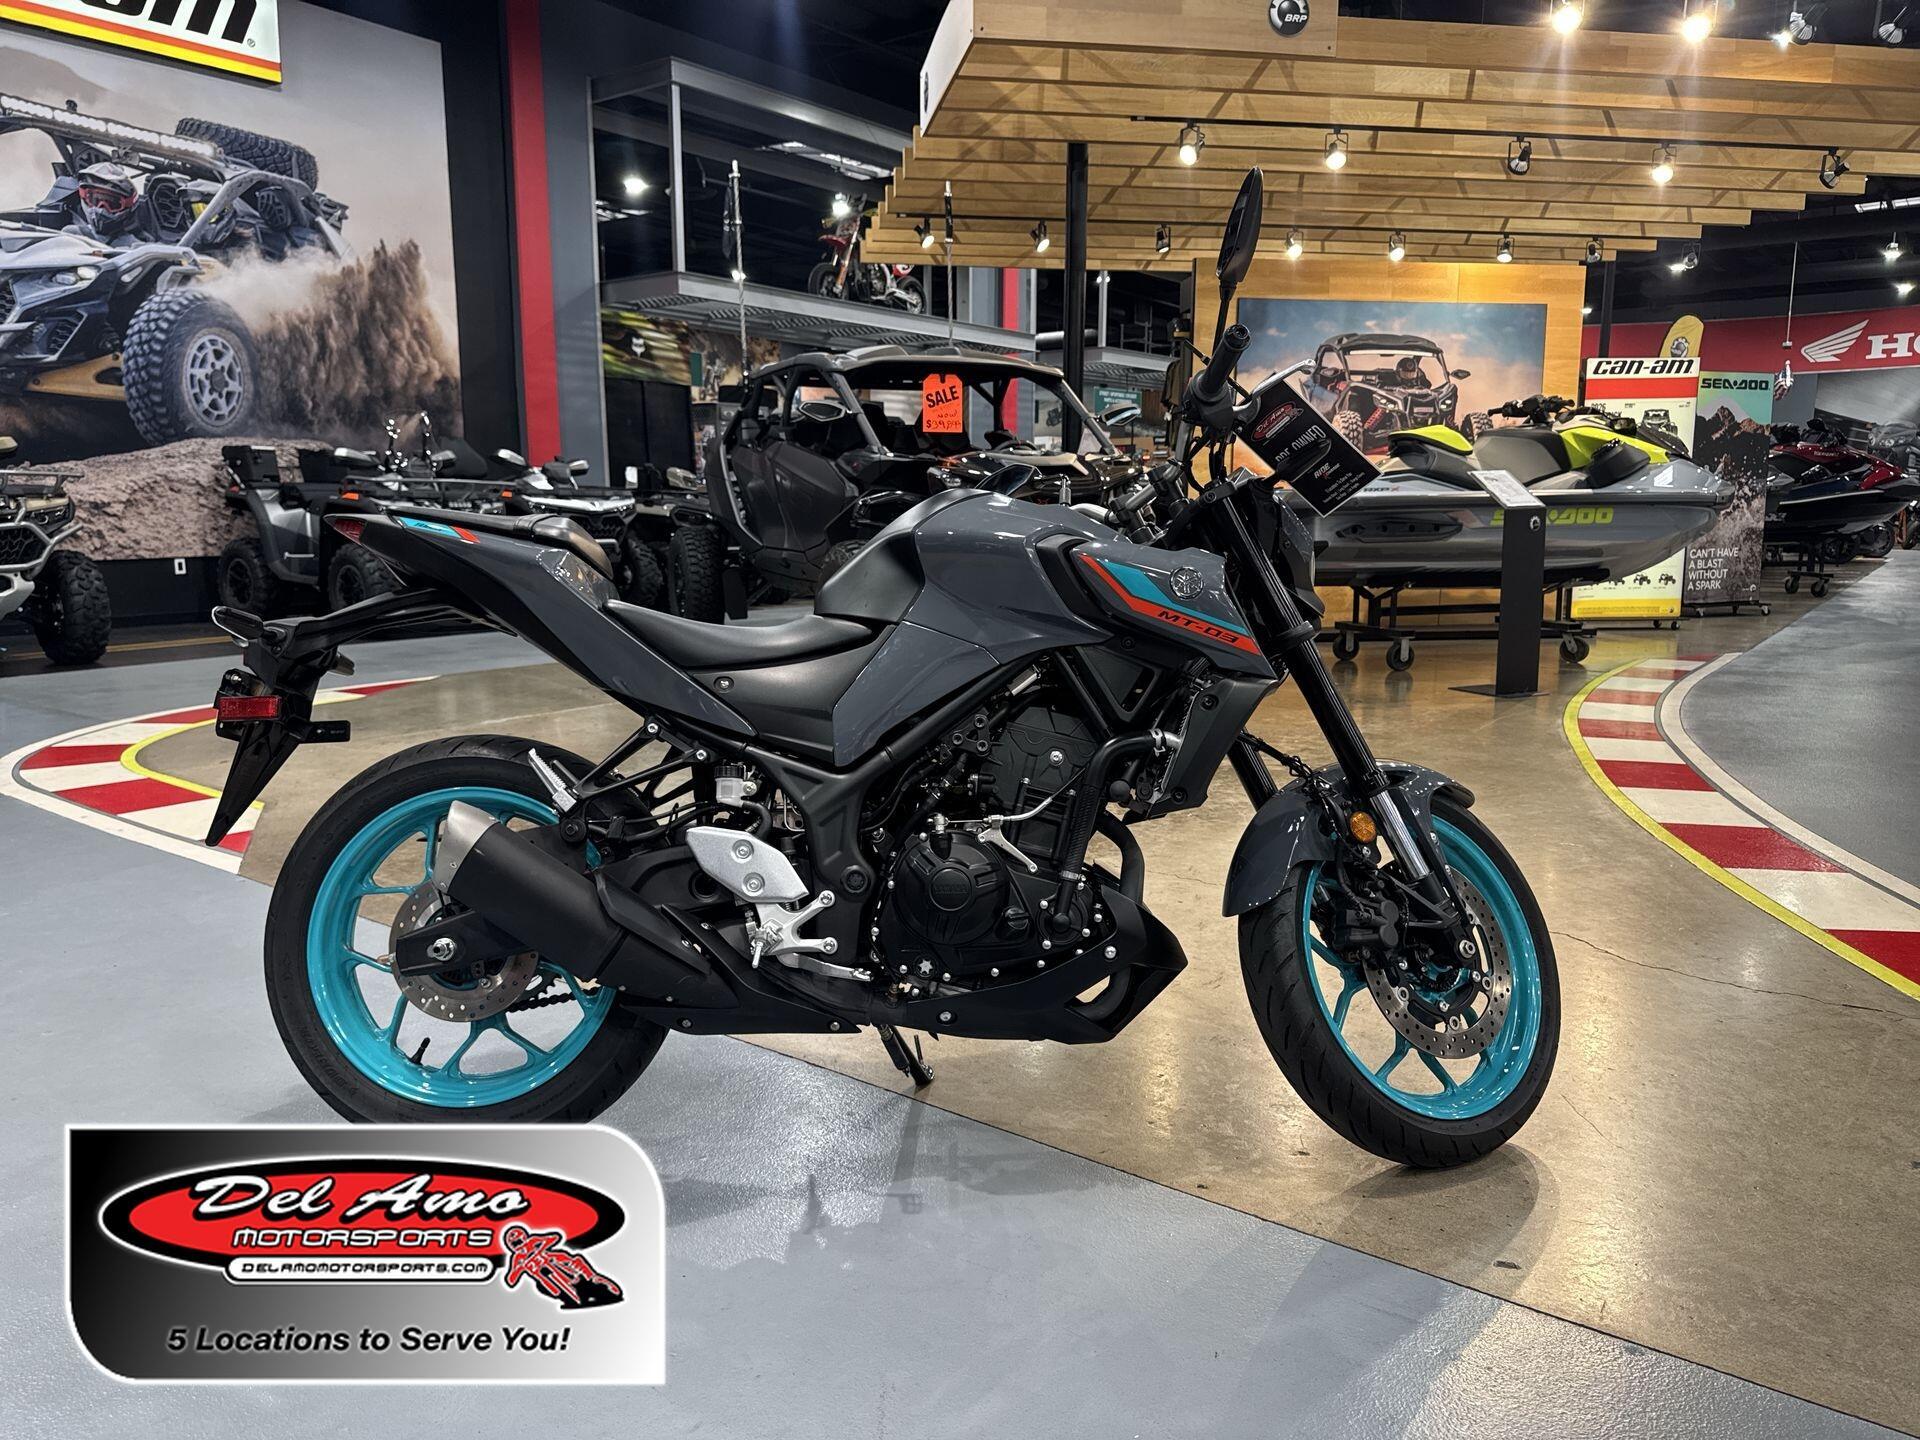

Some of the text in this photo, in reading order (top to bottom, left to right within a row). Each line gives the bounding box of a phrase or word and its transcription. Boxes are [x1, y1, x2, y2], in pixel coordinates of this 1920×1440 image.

[1284, 13, 1307, 22] BRP
[1866, 332, 1920, 360] H
[1593, 359, 1693, 375] can-am
[926, 385, 959, 408] SALE
[1689, 548, 1739, 559] CAN'T HAVE
[1688, 558, 1724, 570] A BLAST
[1688, 569, 1729, 580] WITHOUT
[1687, 580, 1721, 591] A SPARK
[1158, 611, 1239, 643] MT-03
